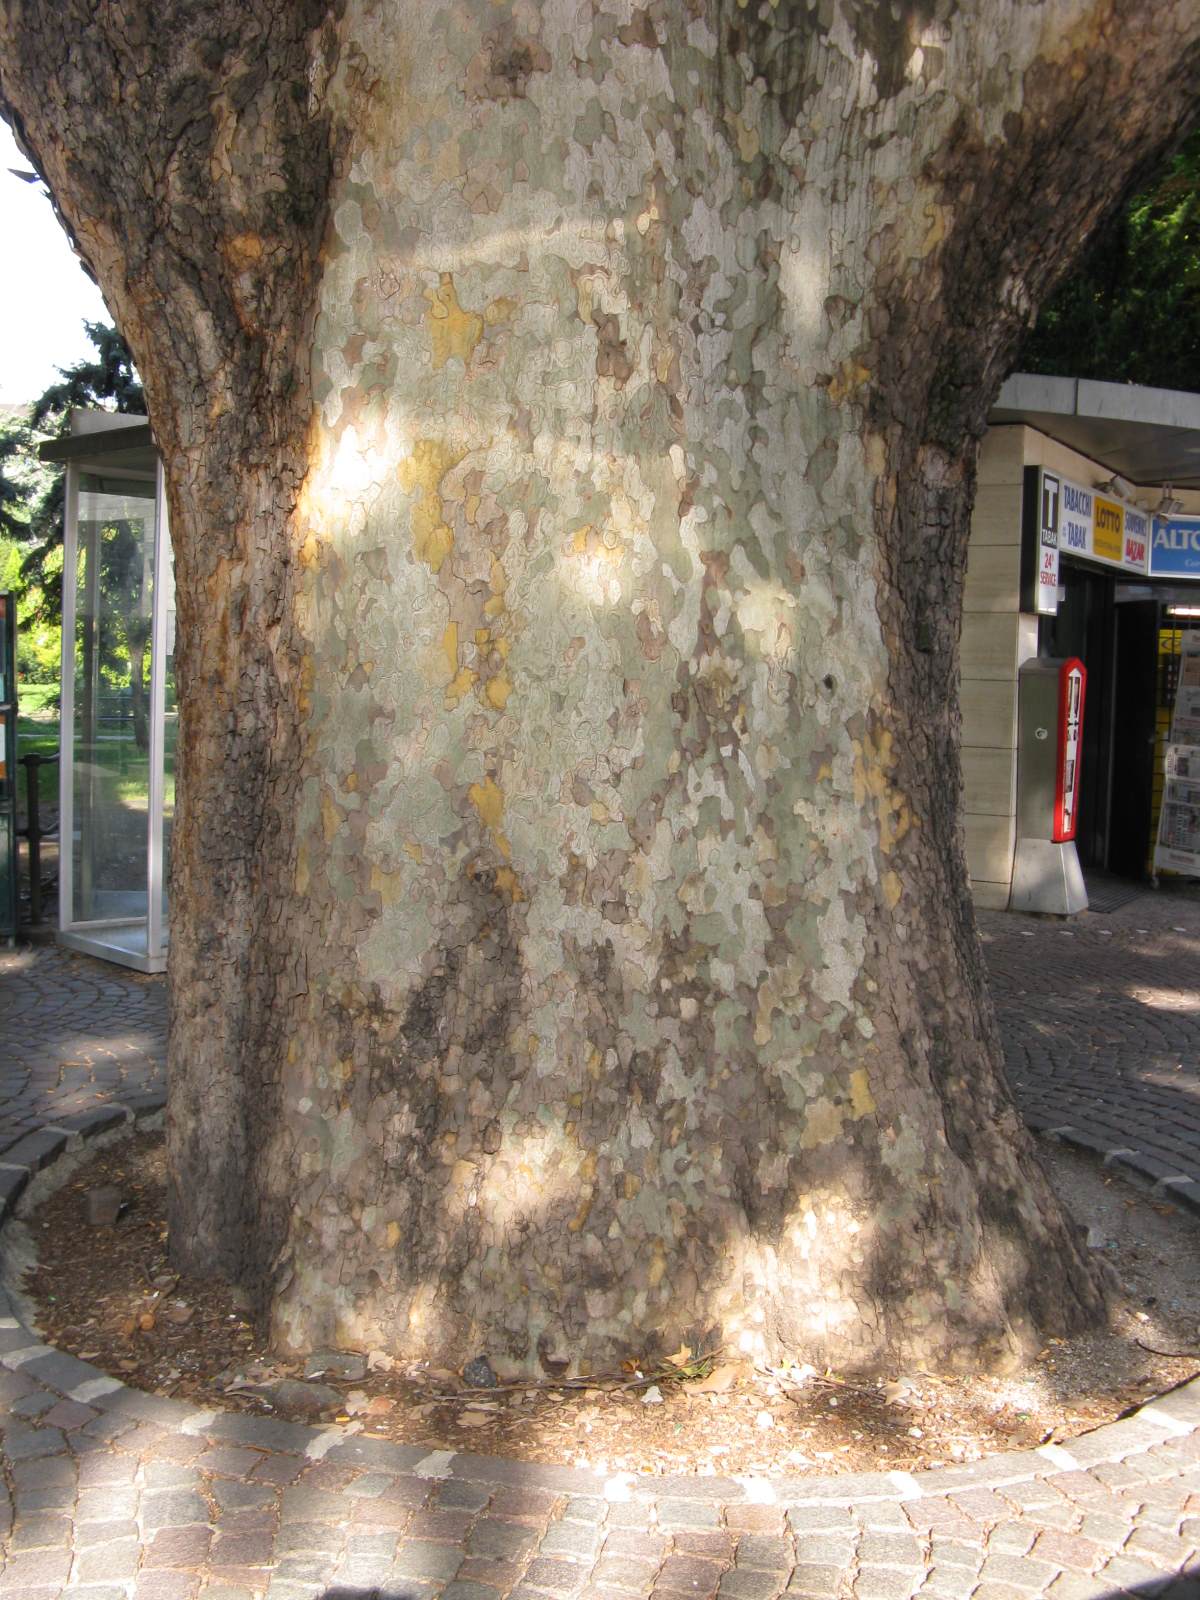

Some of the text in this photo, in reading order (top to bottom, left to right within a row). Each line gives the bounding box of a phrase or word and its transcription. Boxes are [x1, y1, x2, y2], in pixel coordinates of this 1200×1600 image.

[1045, 478, 1058, 528] T
[1064, 485, 1092, 518] TABACCHI
[1096, 504, 1121, 534] LOTTO
[1042, 529, 1058, 546] TABAK
[1067, 522, 1087, 550] TABAK
[1126, 538, 1145, 561] BAZAR
[1040, 570, 1057, 587] SERVICE
